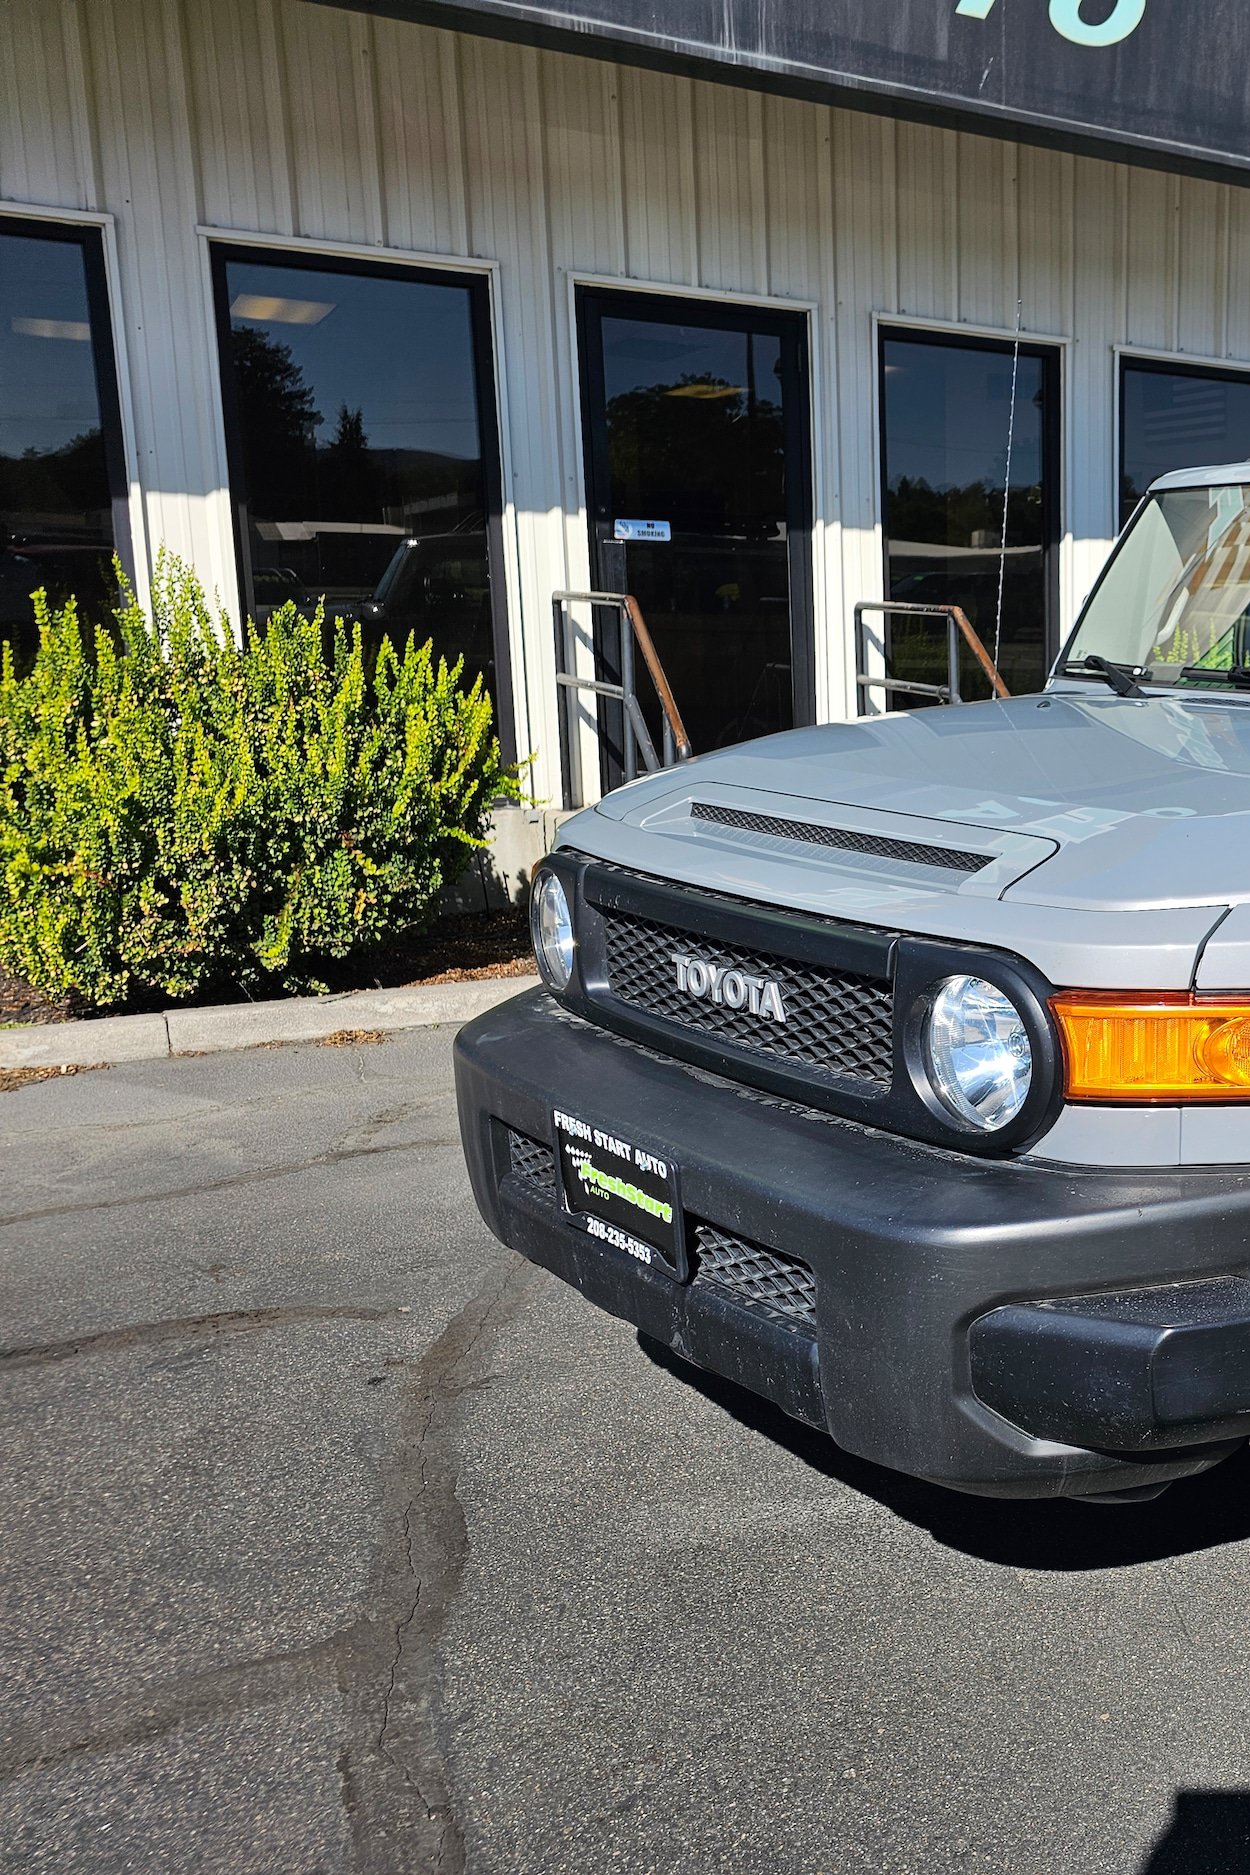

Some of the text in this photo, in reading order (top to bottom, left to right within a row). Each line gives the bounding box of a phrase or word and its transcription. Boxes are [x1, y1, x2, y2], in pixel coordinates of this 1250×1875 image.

[671, 954, 786, 1022] TOYOTA
[554, 1109, 667, 1179] FRESH START AUTO
[579, 1161, 672, 1223] FreshStart
[590, 1186, 610, 1200] AUTO
[586, 1217, 651, 1264] 208-235-5353
